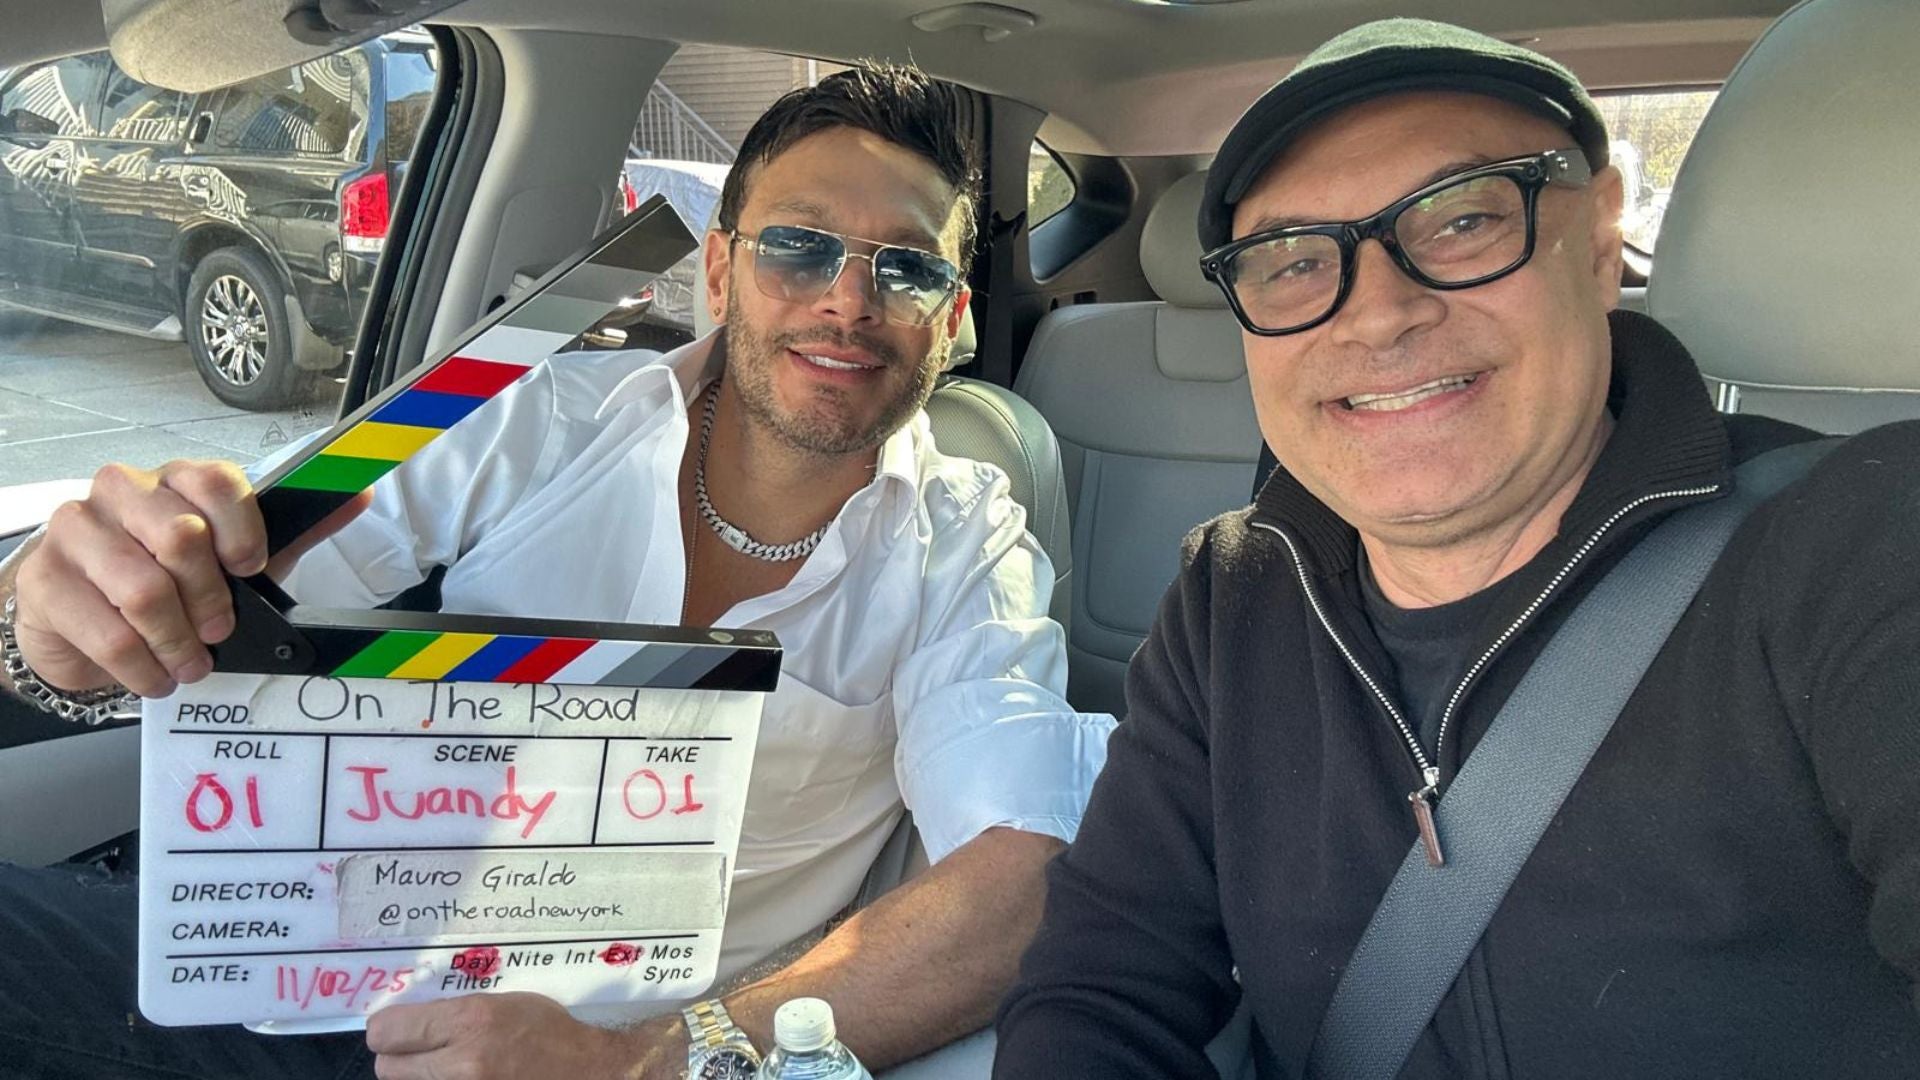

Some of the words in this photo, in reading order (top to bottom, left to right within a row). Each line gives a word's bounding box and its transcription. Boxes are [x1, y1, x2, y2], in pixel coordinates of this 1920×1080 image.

[297, 675, 383, 721] On
[408, 680, 502, 723] The
[514, 682, 640, 723] Road
[214, 741, 283, 760] ROLL
[434, 745, 518, 763] SCENE
[645, 746, 700, 764] TAKE
[185, 773, 264, 832] 01
[345, 766, 557, 839] Juandy
[623, 769, 704, 820] 01
[376, 860, 462, 886] Mauro
[482, 860, 577, 892] Giraldo
[171, 881, 315, 903] DIRECTOR:
[378, 897, 624, 926] @ontheroadnewyork
[172, 921, 290, 941] CAMERA:
[450, 953, 497, 973] Day
[506, 950, 555, 968] Nite
[565, 948, 596, 964] Int
[604, 946, 643, 963] Ext
[650, 943, 695, 961] Mos
[171, 964, 250, 984] DATE:
[277, 965, 415, 1010] 11/02/25
[441, 974, 503, 991] Filter
[643, 965, 694, 985] Sync
